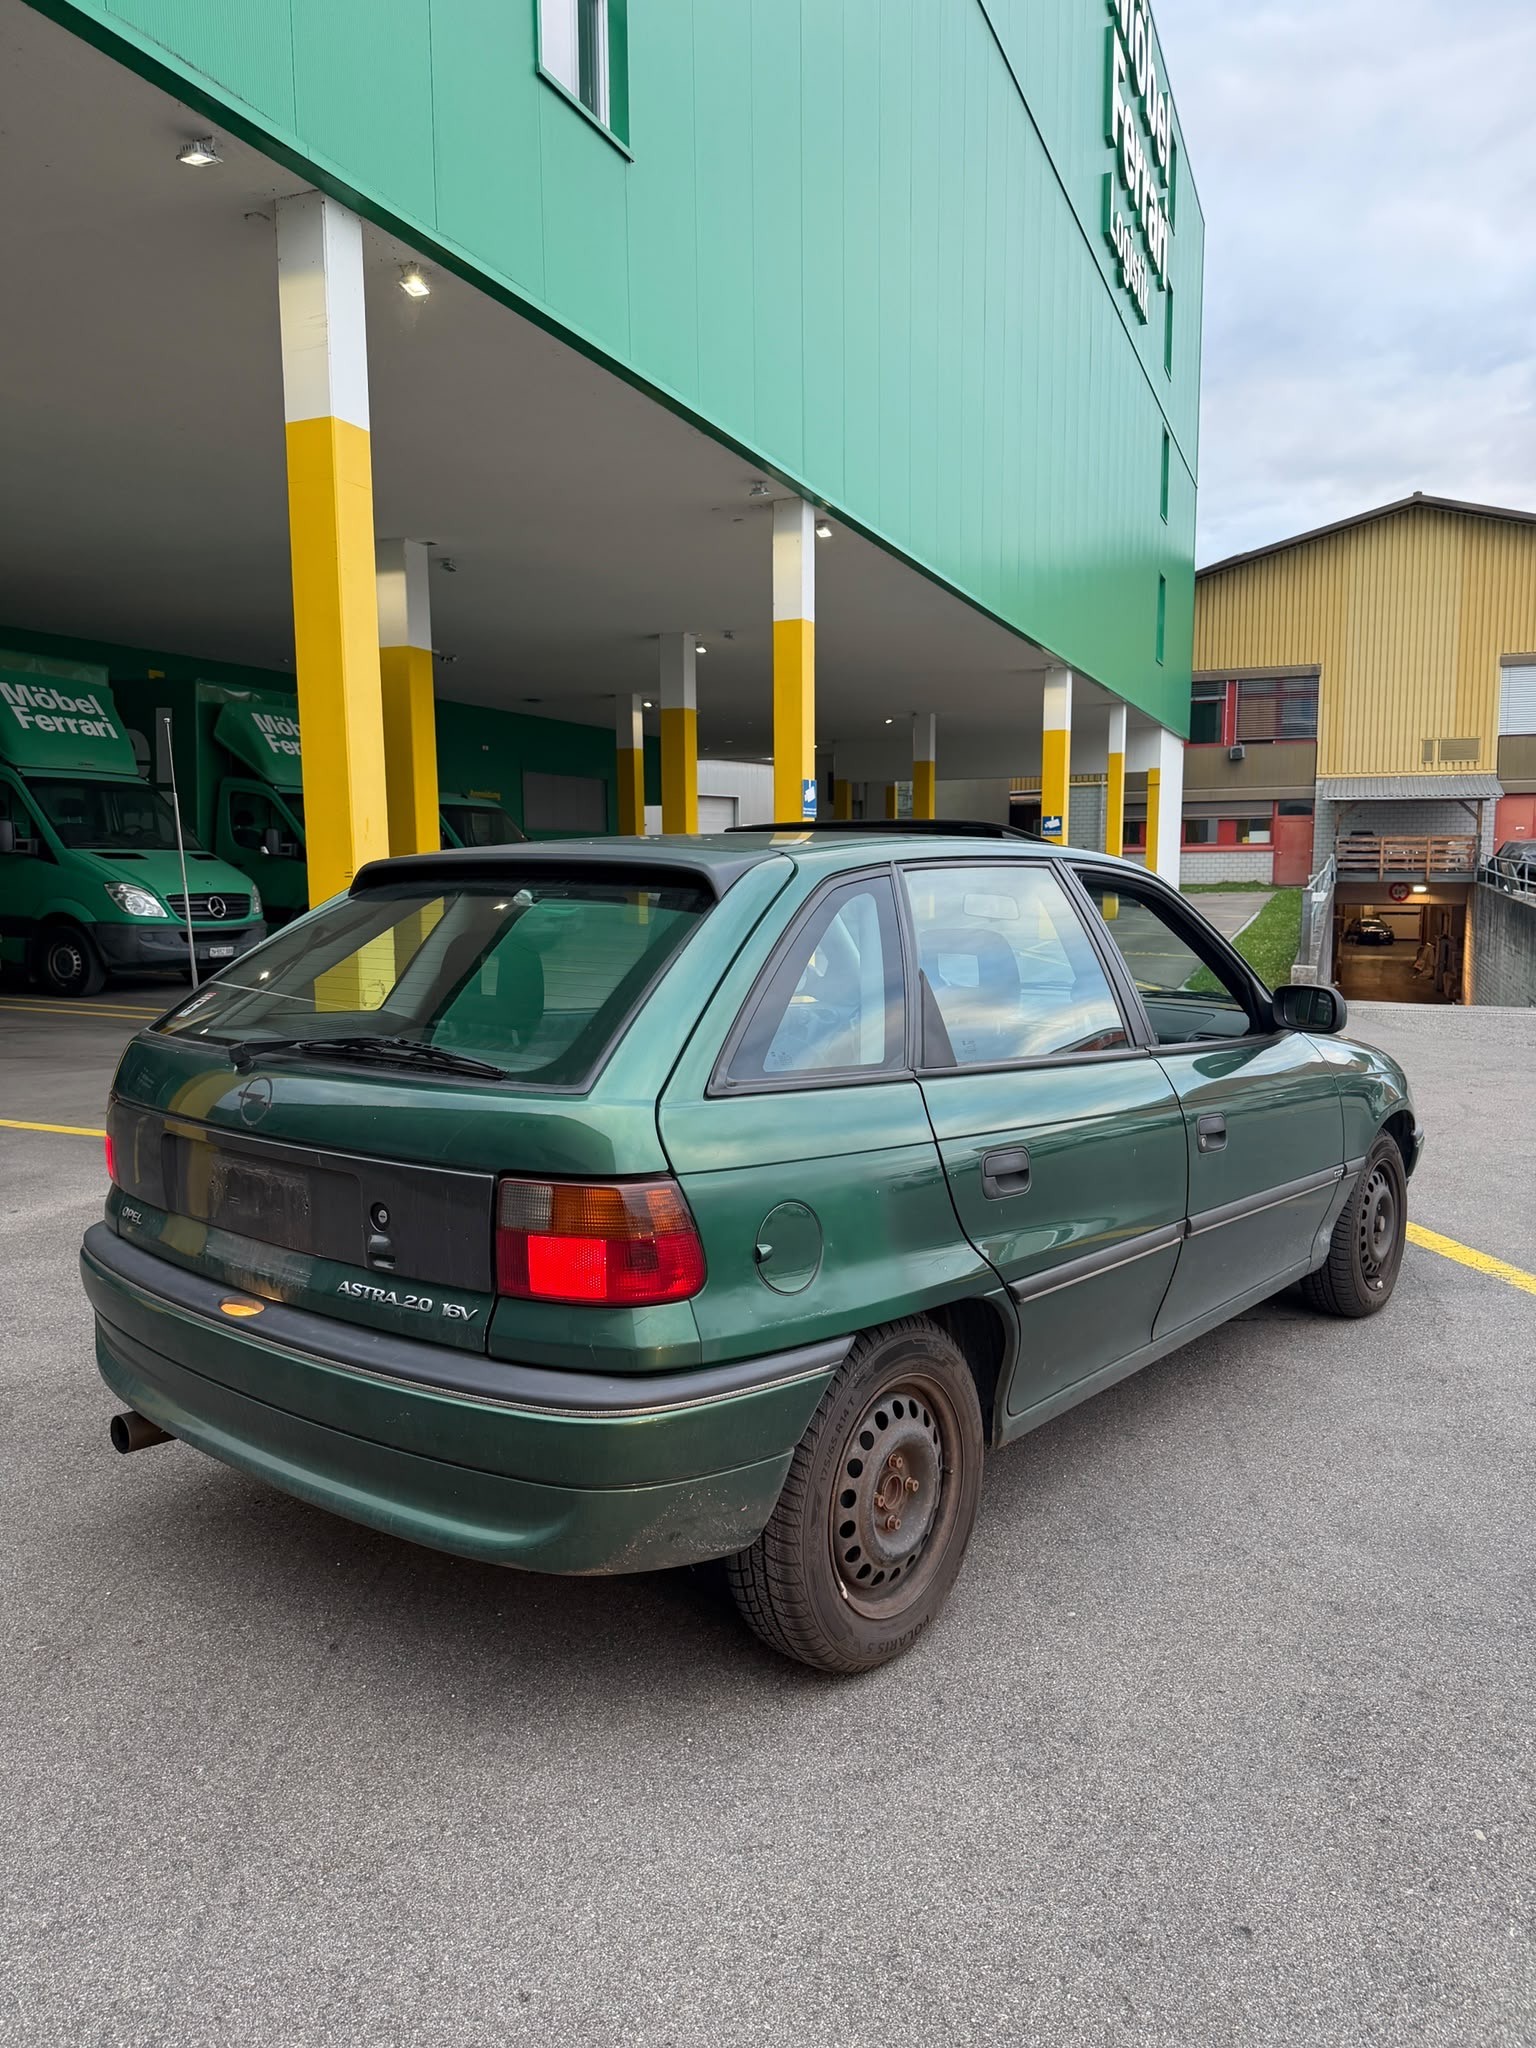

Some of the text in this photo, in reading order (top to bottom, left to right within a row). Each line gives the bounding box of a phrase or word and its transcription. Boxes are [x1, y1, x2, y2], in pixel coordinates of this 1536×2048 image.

[1111, 24, 1169, 291] Ferrari
[1110, 172, 1149, 325] Logistik
[0, 682, 106, 716] Möbel
[10, 705, 119, 739] Ferrari
[251, 712, 301, 737] Möb
[122, 1206, 142, 1225] OPEL
[336, 1280, 399, 1306] ASTRA
[441, 1302, 479, 1321] 16V
[876, 1613, 930, 1656] POLARIS
